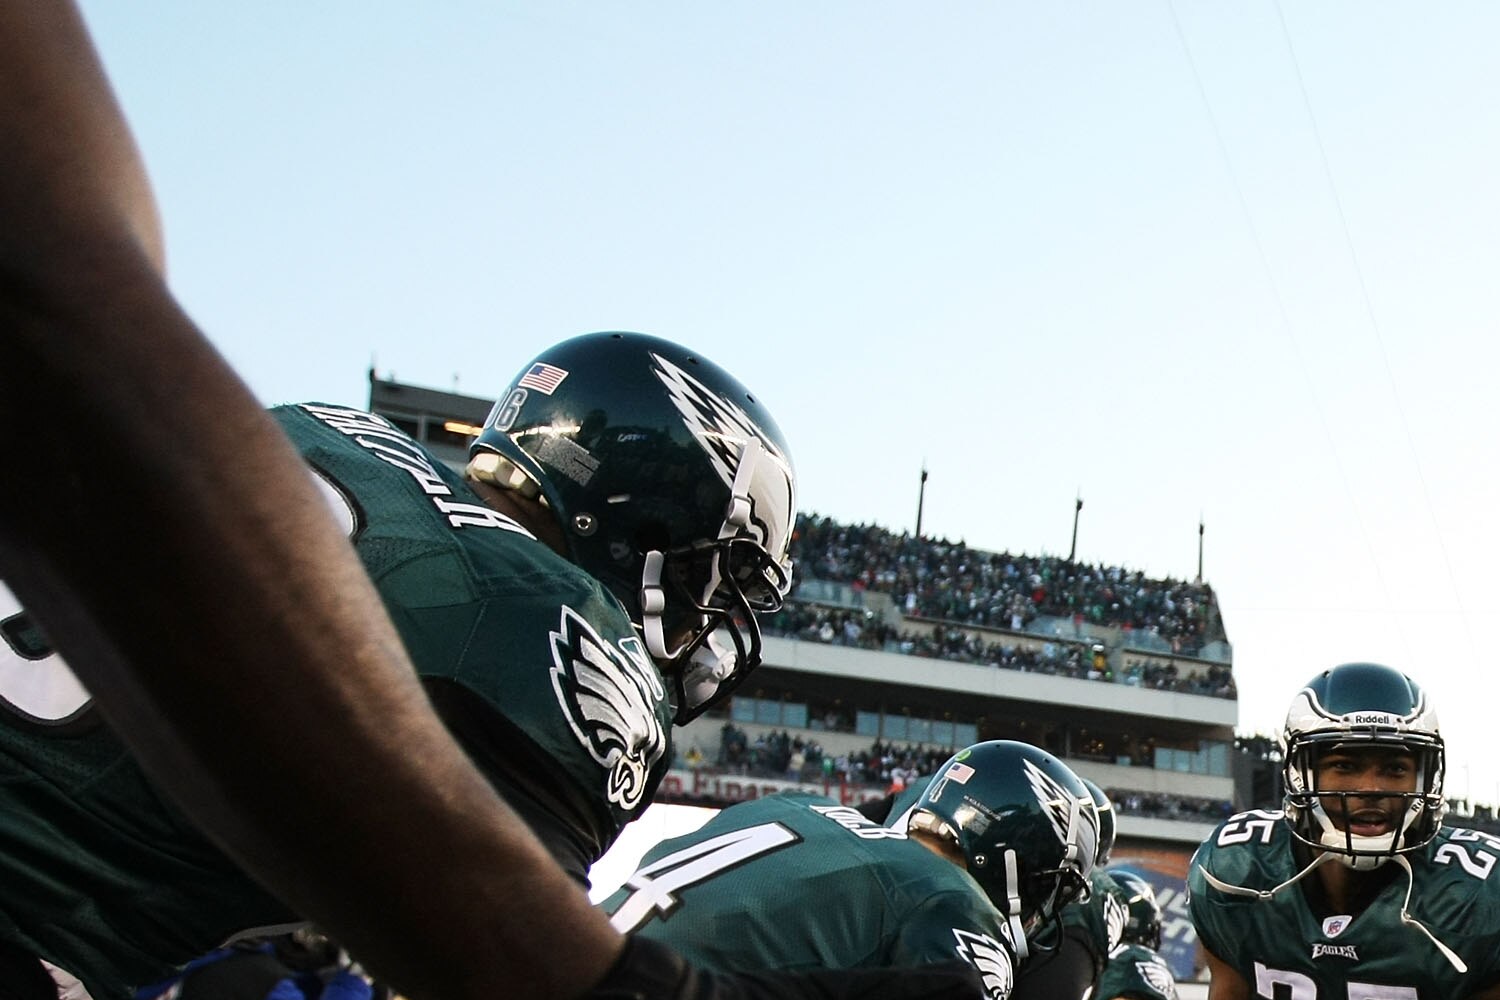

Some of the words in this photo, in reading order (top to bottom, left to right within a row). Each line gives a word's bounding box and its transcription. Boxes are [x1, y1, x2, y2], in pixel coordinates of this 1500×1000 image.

[483, 384, 528, 432] 6
[1355, 714, 1390, 725] Riddell
[605, 820, 798, 936] 4
[1311, 943, 1360, 961] EAGLES
